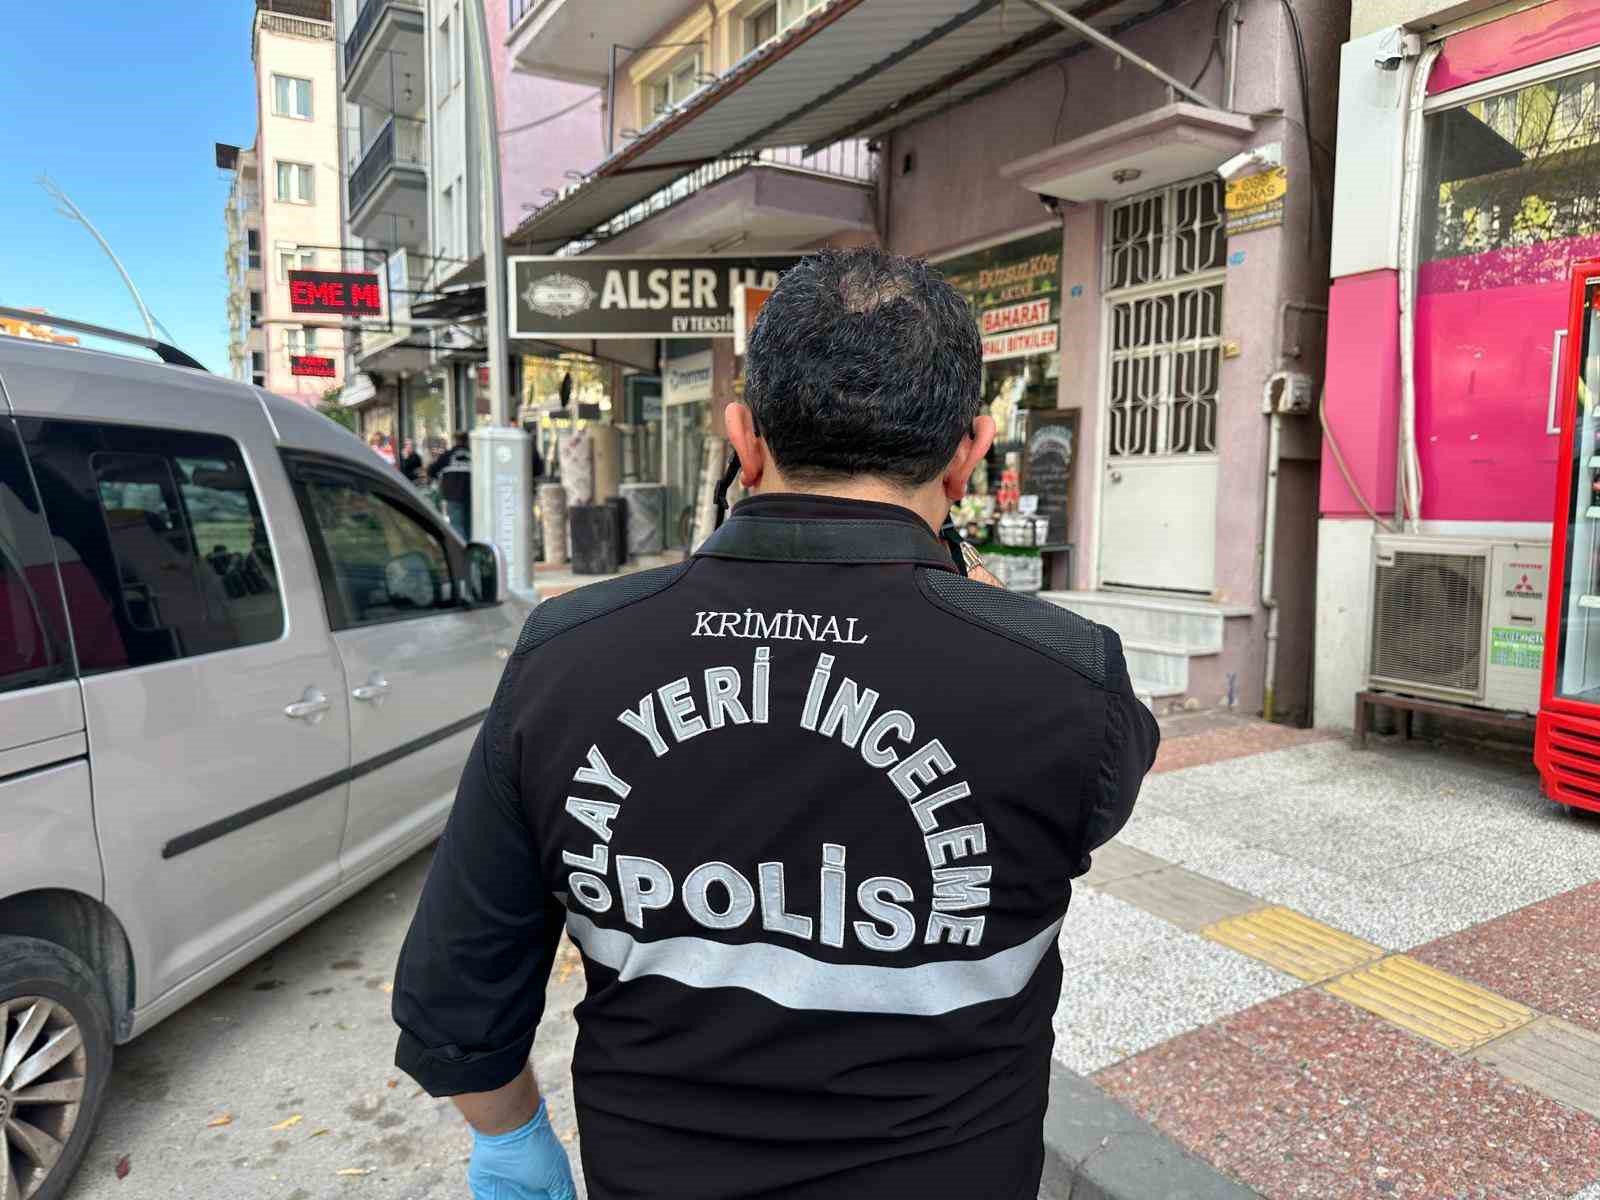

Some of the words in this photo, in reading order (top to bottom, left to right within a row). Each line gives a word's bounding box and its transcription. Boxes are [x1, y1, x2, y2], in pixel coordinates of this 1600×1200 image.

[600, 268, 718, 309] ALSER
[671, 315, 688, 332] EV
[983, 302, 1048, 332] BAHARAT
[691, 608, 868, 644] KRİMİNAL
[562, 744, 632, 913] OLAY
[617, 646, 771, 758] YERİ
[800, 653, 992, 947] İNCELEME
[615, 842, 916, 952] POLİS
